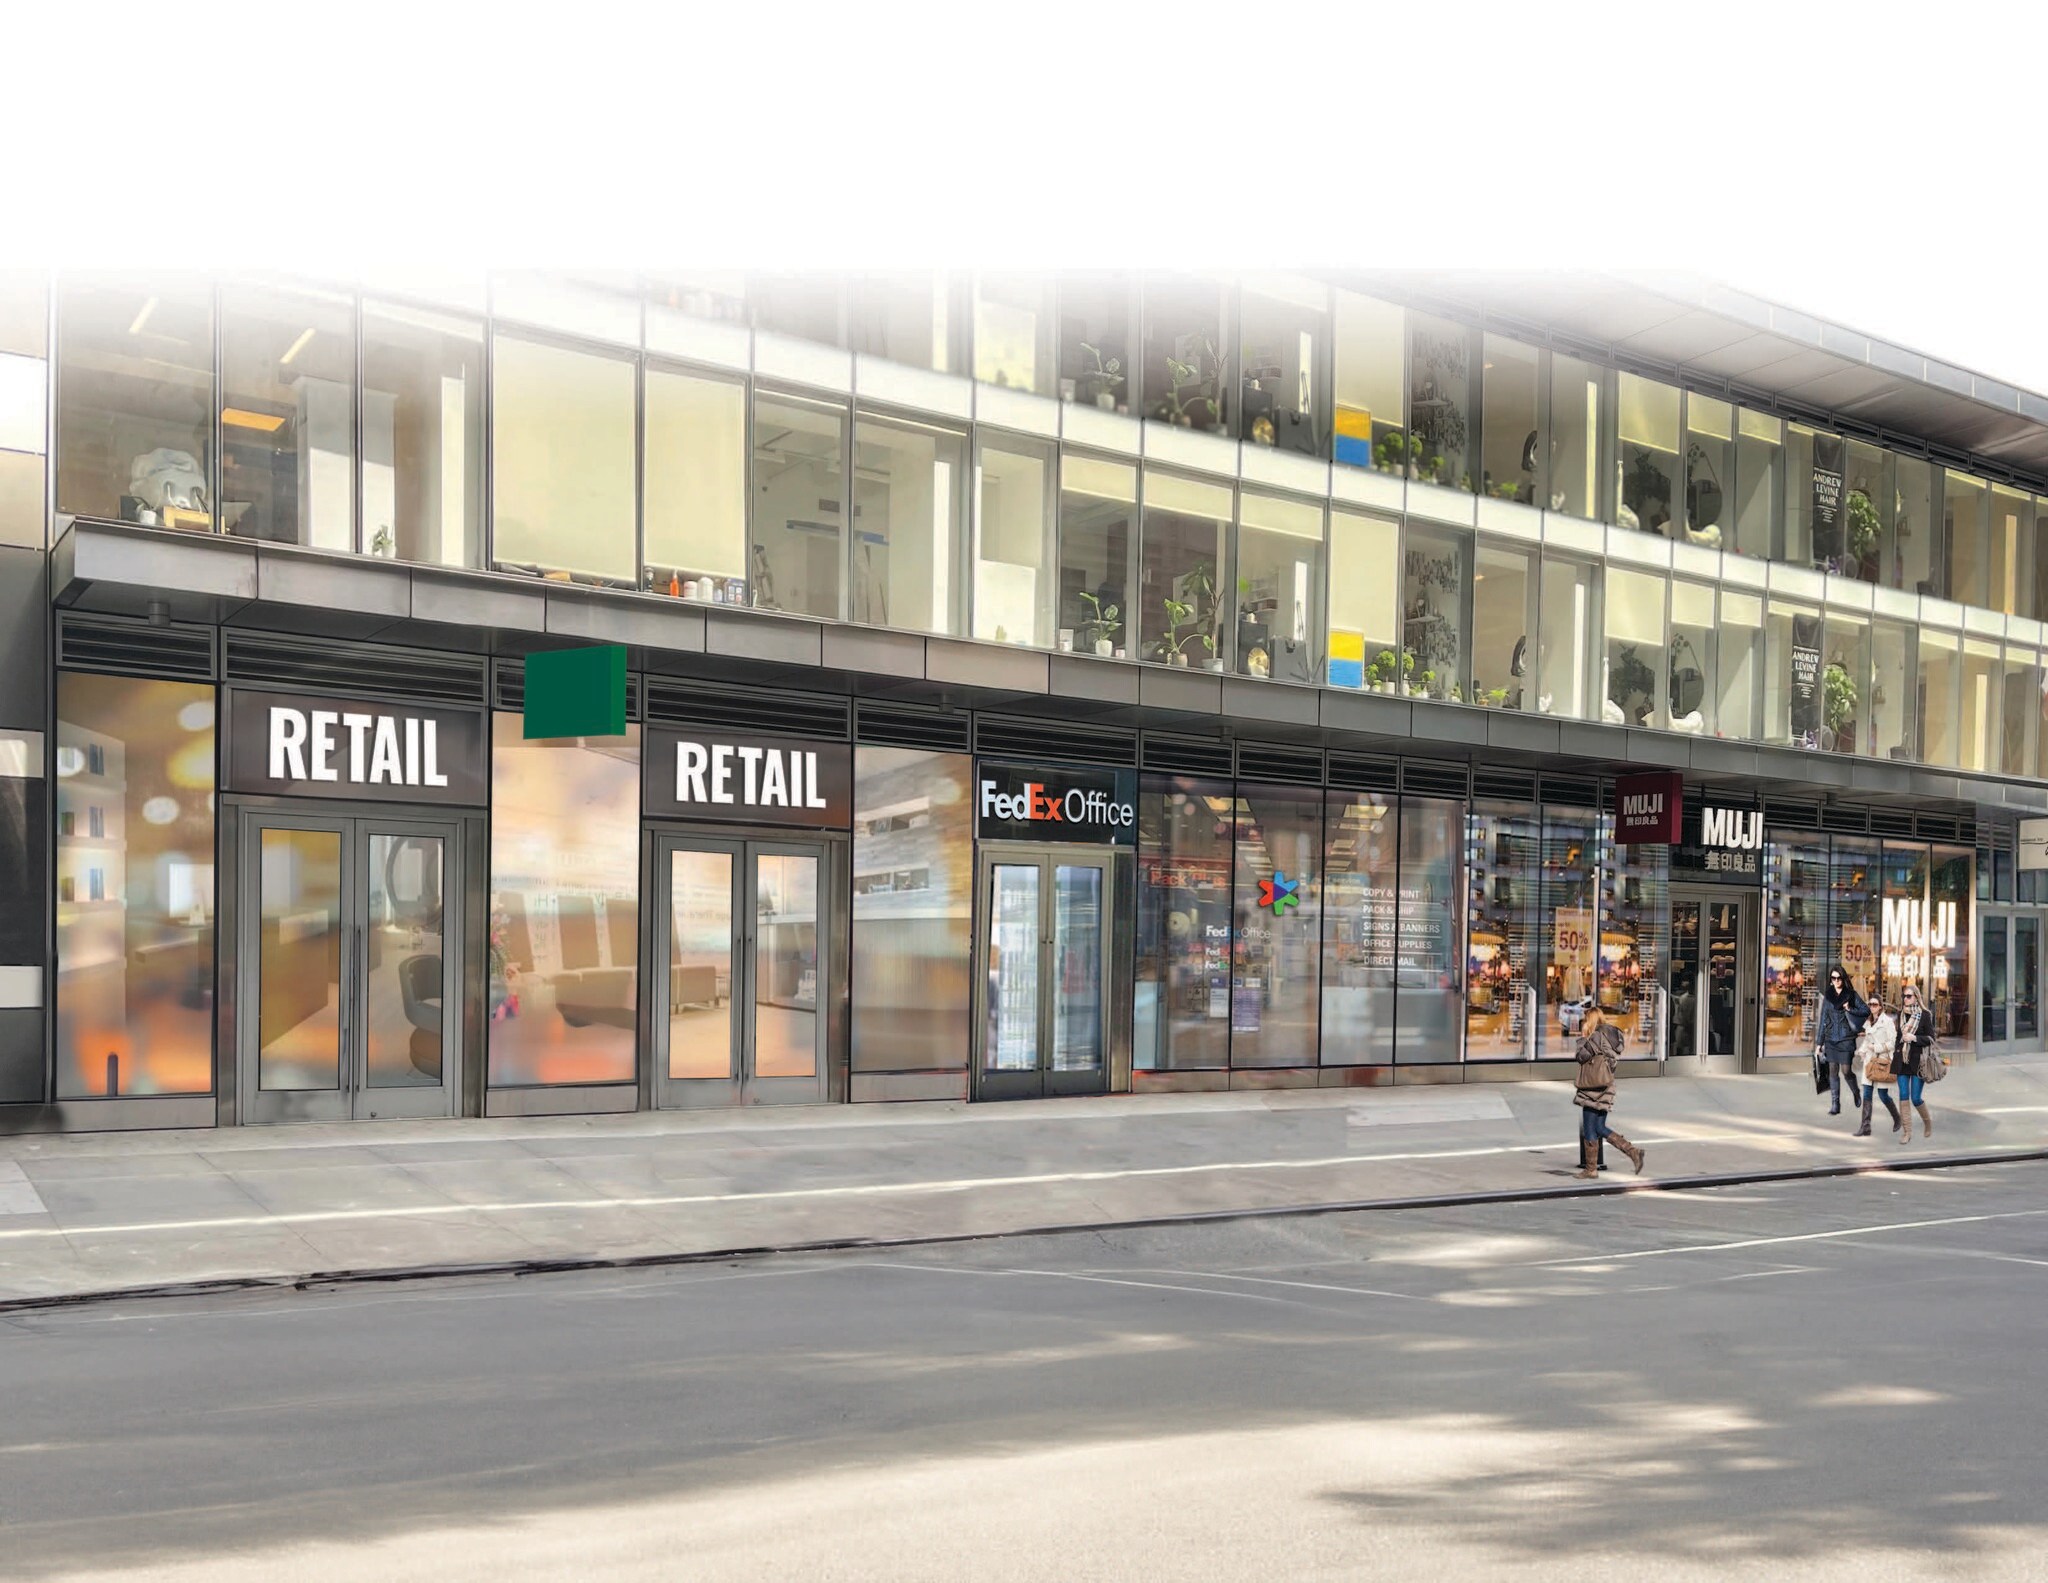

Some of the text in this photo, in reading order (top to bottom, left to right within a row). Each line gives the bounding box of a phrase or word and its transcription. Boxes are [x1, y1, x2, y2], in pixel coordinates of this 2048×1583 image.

[1813, 473, 1842, 488] ANDREW
[1816, 483, 1839, 498] LEVINE
[1820, 495, 1837, 506] HAIR
[1792, 651, 1820, 664] ANDREW
[1795, 661, 1817, 673] LEVINE
[268, 706, 448, 787] RETAIL
[674, 740, 827, 809] RETAIL
[981, 780, 1134, 827] FedEx Office
[1623, 793, 1664, 815] MUJI
[1626, 815, 1659, 826] 無印良品
[1702, 807, 1763, 850] MUJI
[1705, 850, 1756, 873] 無印良品
[1363, 887, 1386, 897] COPY
[1386, 889, 1394, 897] &
[1362, 904, 1415, 916] PACK & HIP
[1363, 921, 1390, 932] SIGNS
[1399, 923, 1441, 934] BANNERS
[1881, 897, 1957, 949] MUJI
[1240, 927, 1271, 939] Office
[1363, 938, 1433, 949] OFFICE UPPLIES
[1364, 955, 1416, 967] DIRECT MAIL
